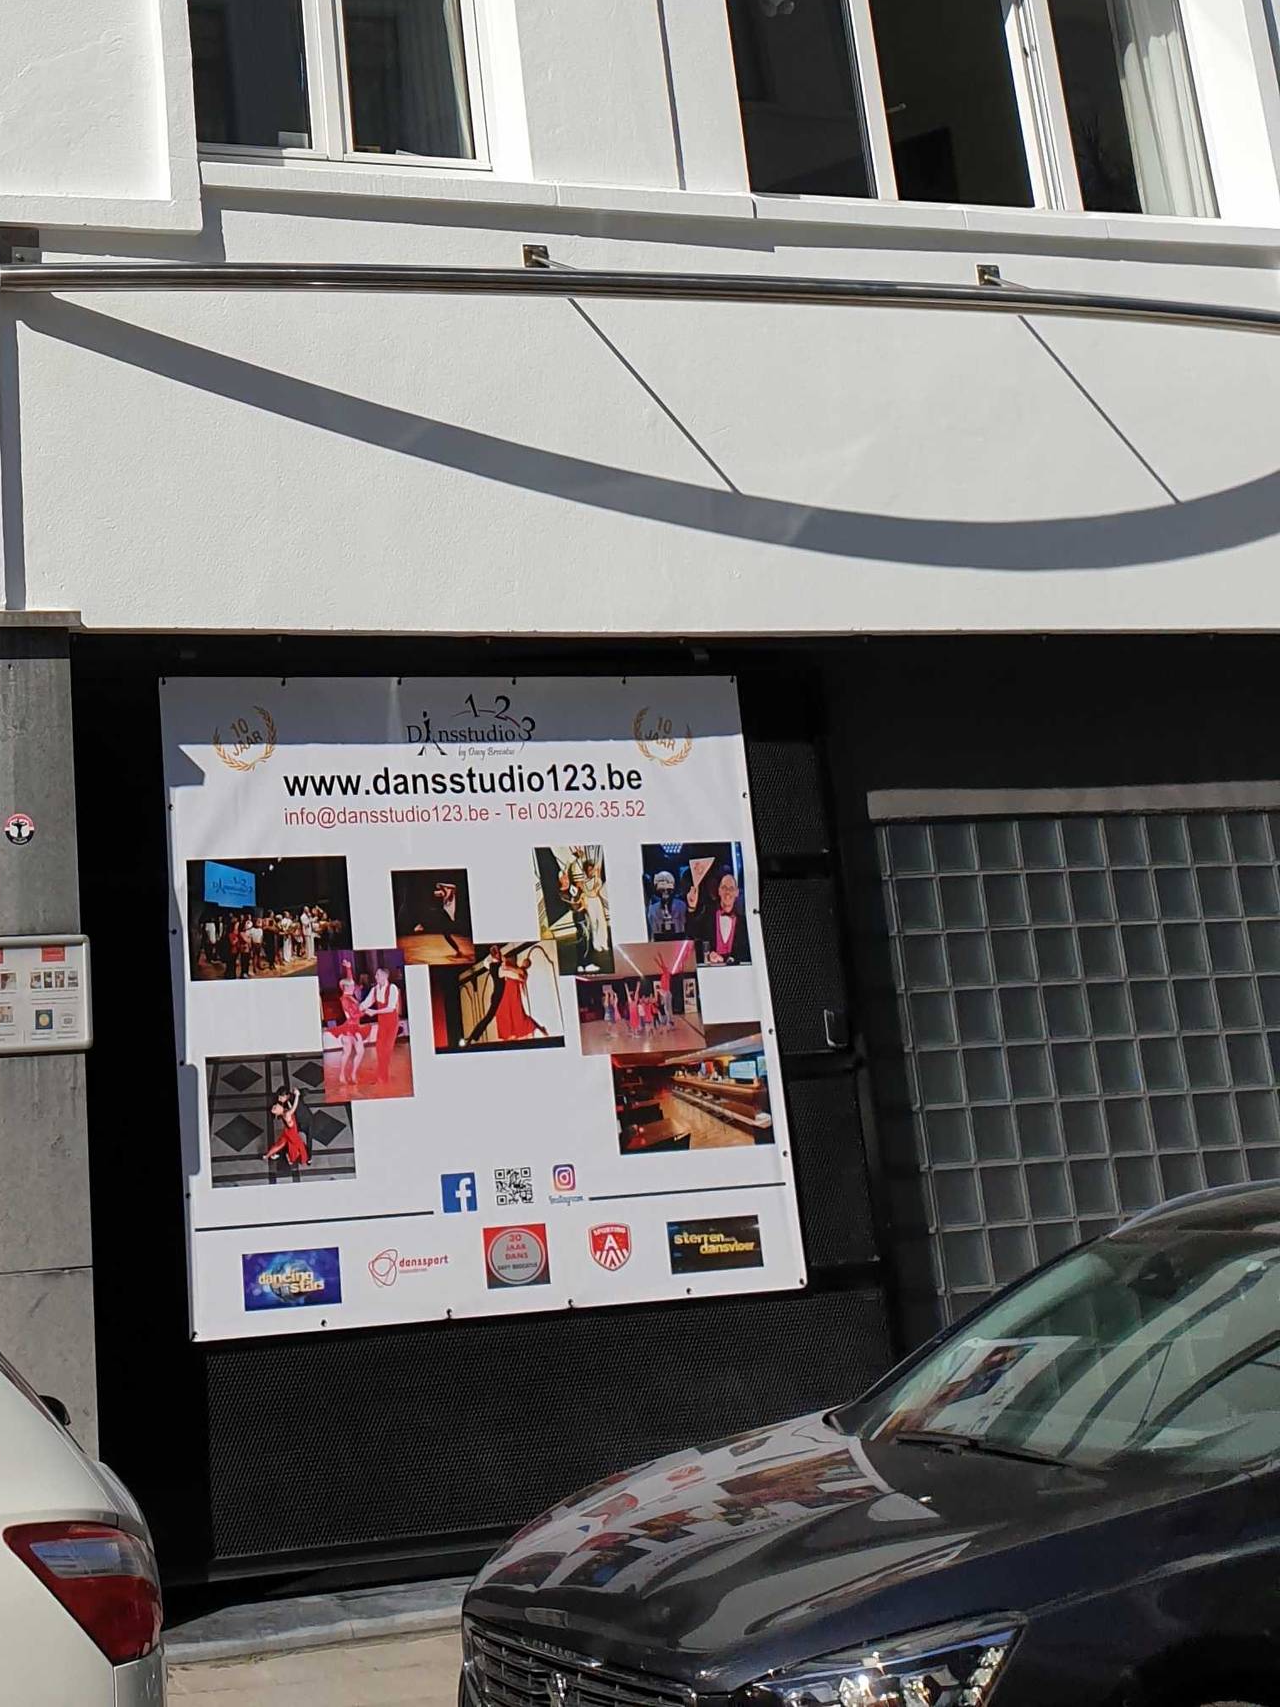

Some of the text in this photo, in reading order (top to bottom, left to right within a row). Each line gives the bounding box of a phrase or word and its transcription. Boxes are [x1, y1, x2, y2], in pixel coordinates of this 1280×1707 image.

[231, 718, 249, 738] 10
[657, 716, 673, 735] 10
[233, 730, 263, 756] JAAR
[645, 730, 676, 751] JAAR
[283, 763, 643, 797] www.dansstudio123.be
[283, 804, 490, 828] info@dansstudio123.be
[505, 803, 532, 820] Tel
[537, 800, 646, 820] 03/226.35.52
[674, 1232, 724, 1245] sterren
[700, 1240, 755, 1255] dansvloer
[399, 1255, 449, 1268] danssport
[258, 1268, 314, 1286] dancing
